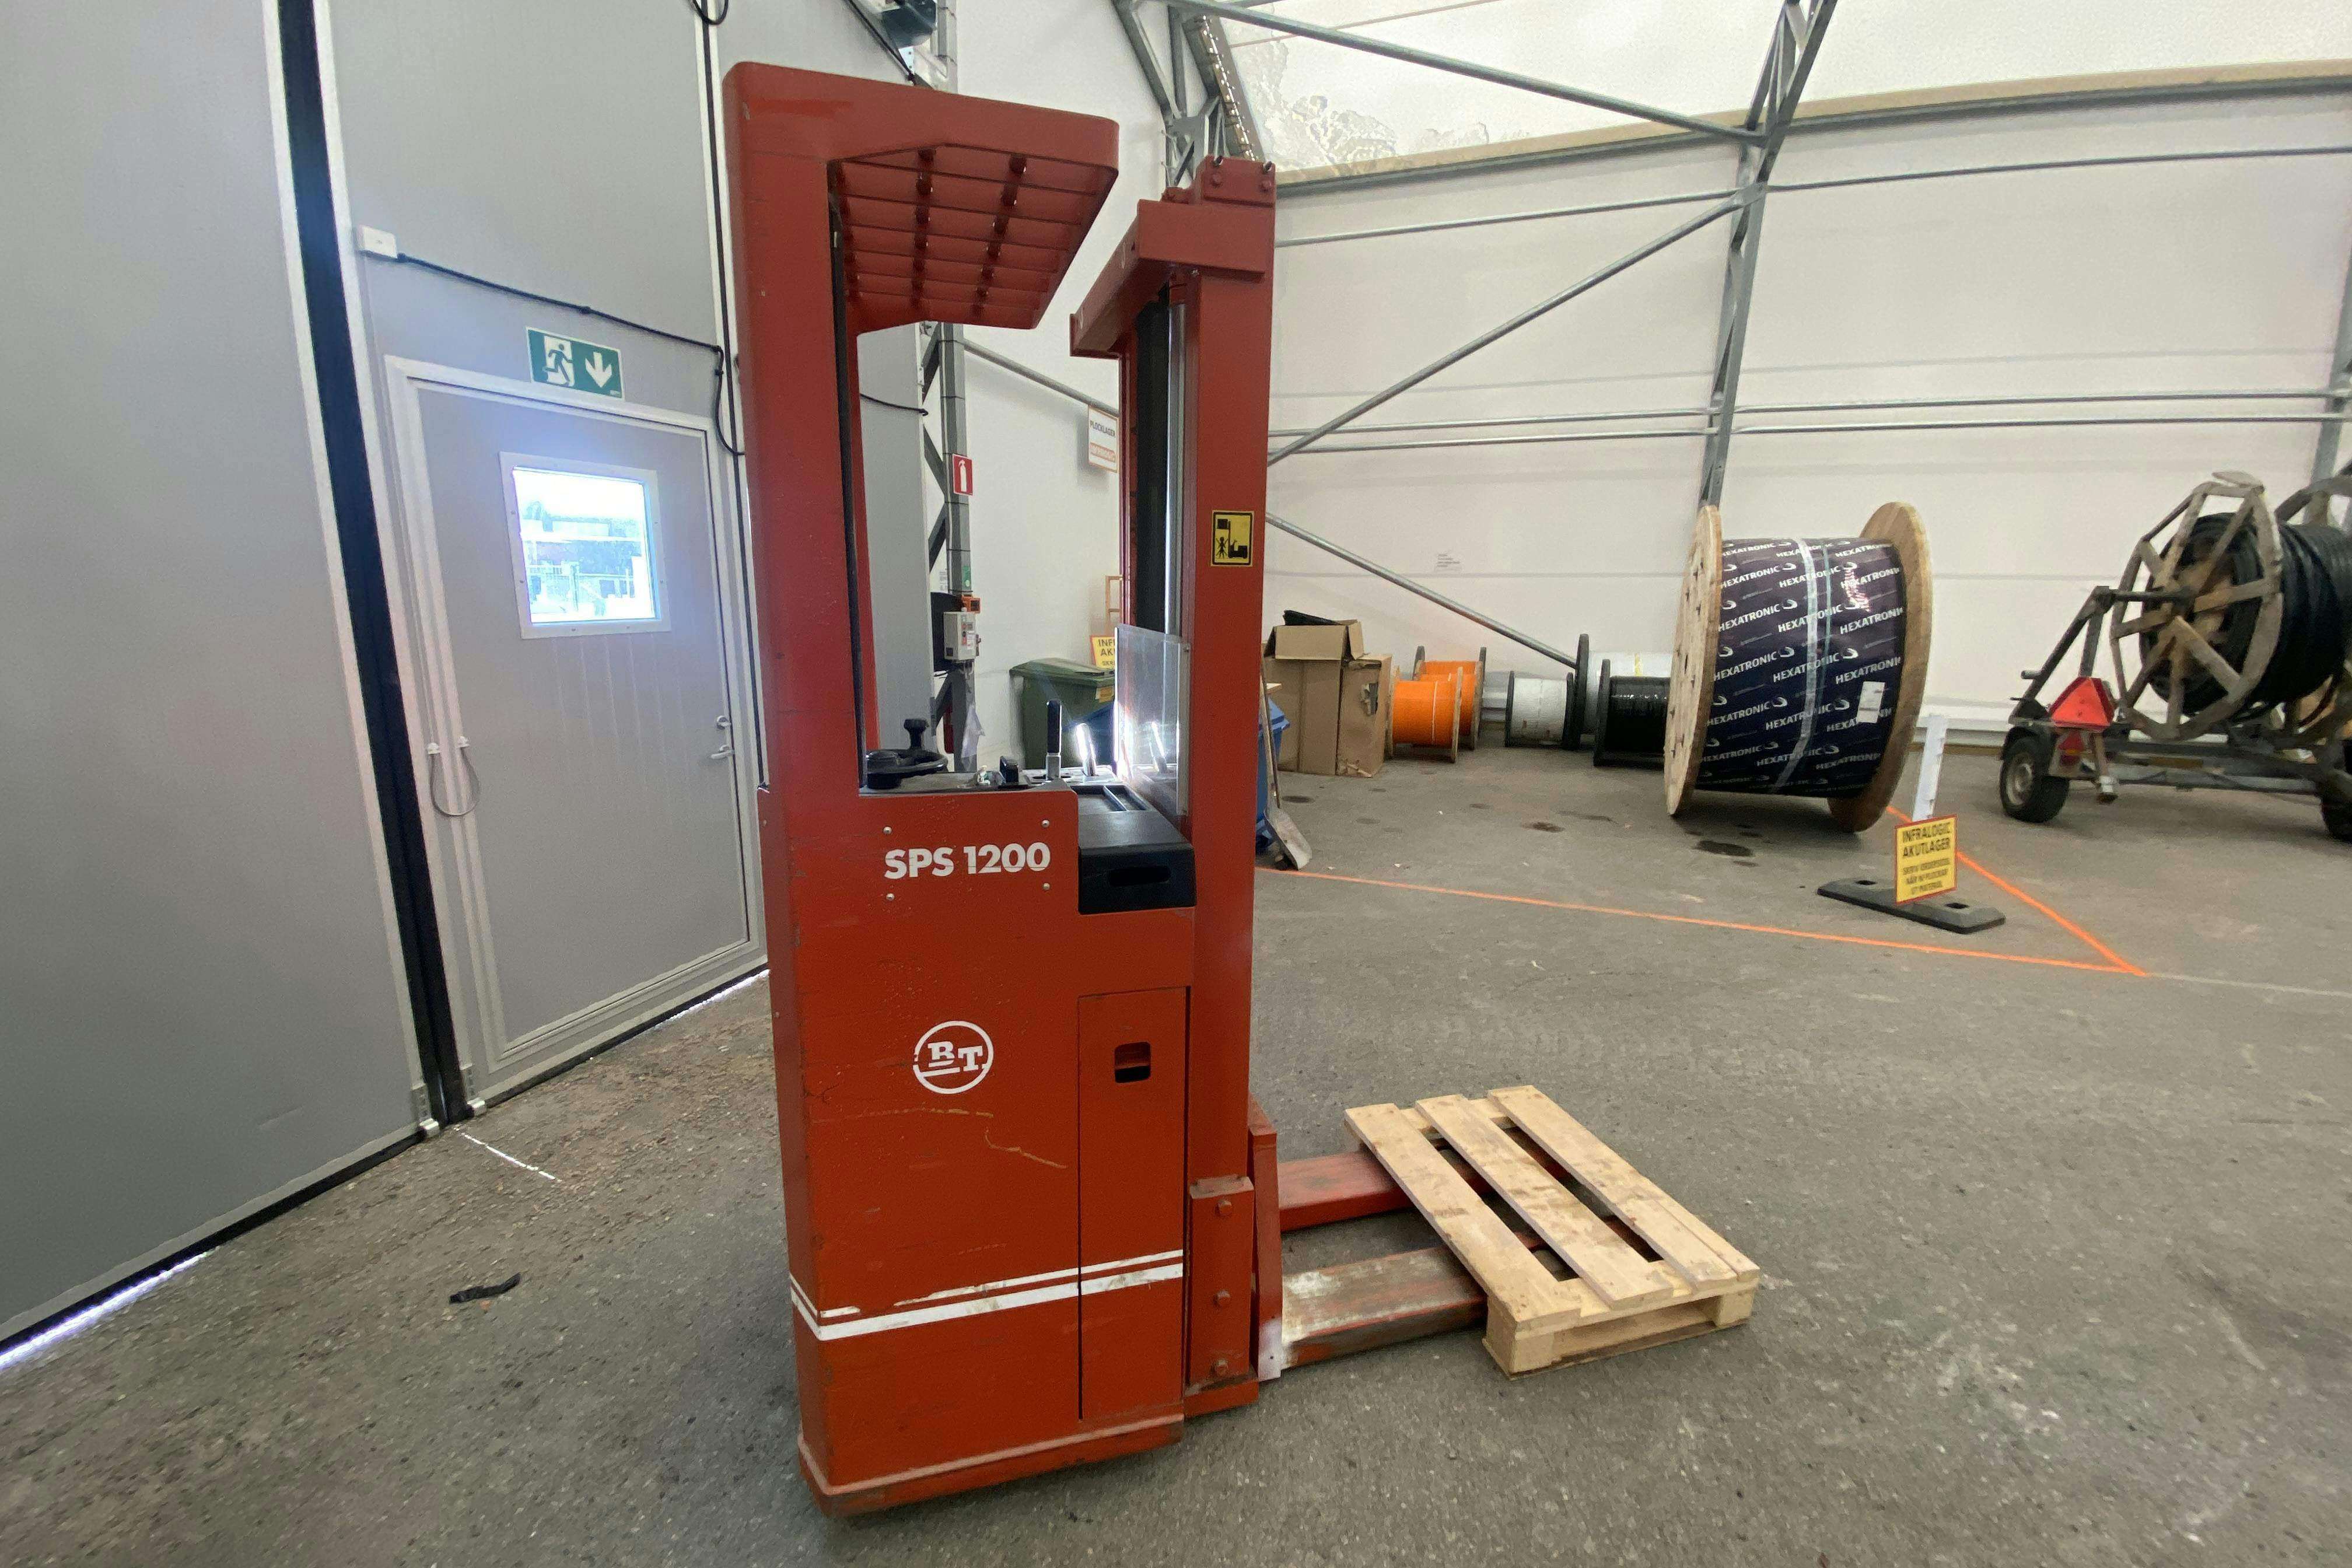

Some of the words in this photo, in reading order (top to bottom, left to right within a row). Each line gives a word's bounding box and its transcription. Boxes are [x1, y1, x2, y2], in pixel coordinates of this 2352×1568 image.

[1718, 604, 1780, 632] HEXATRONIC
[1101, 648, 1115, 656] AK
[1713, 651, 1777, 681] HEXATRONIC
[1707, 701, 1770, 727] HEXATRONIC
[1902, 821, 1951, 843] INFRALOGIC
[884, 846, 954, 880] SPS
[963, 842, 1051, 874] 1200
[1903, 838, 1950, 859] AKUTLAGER
